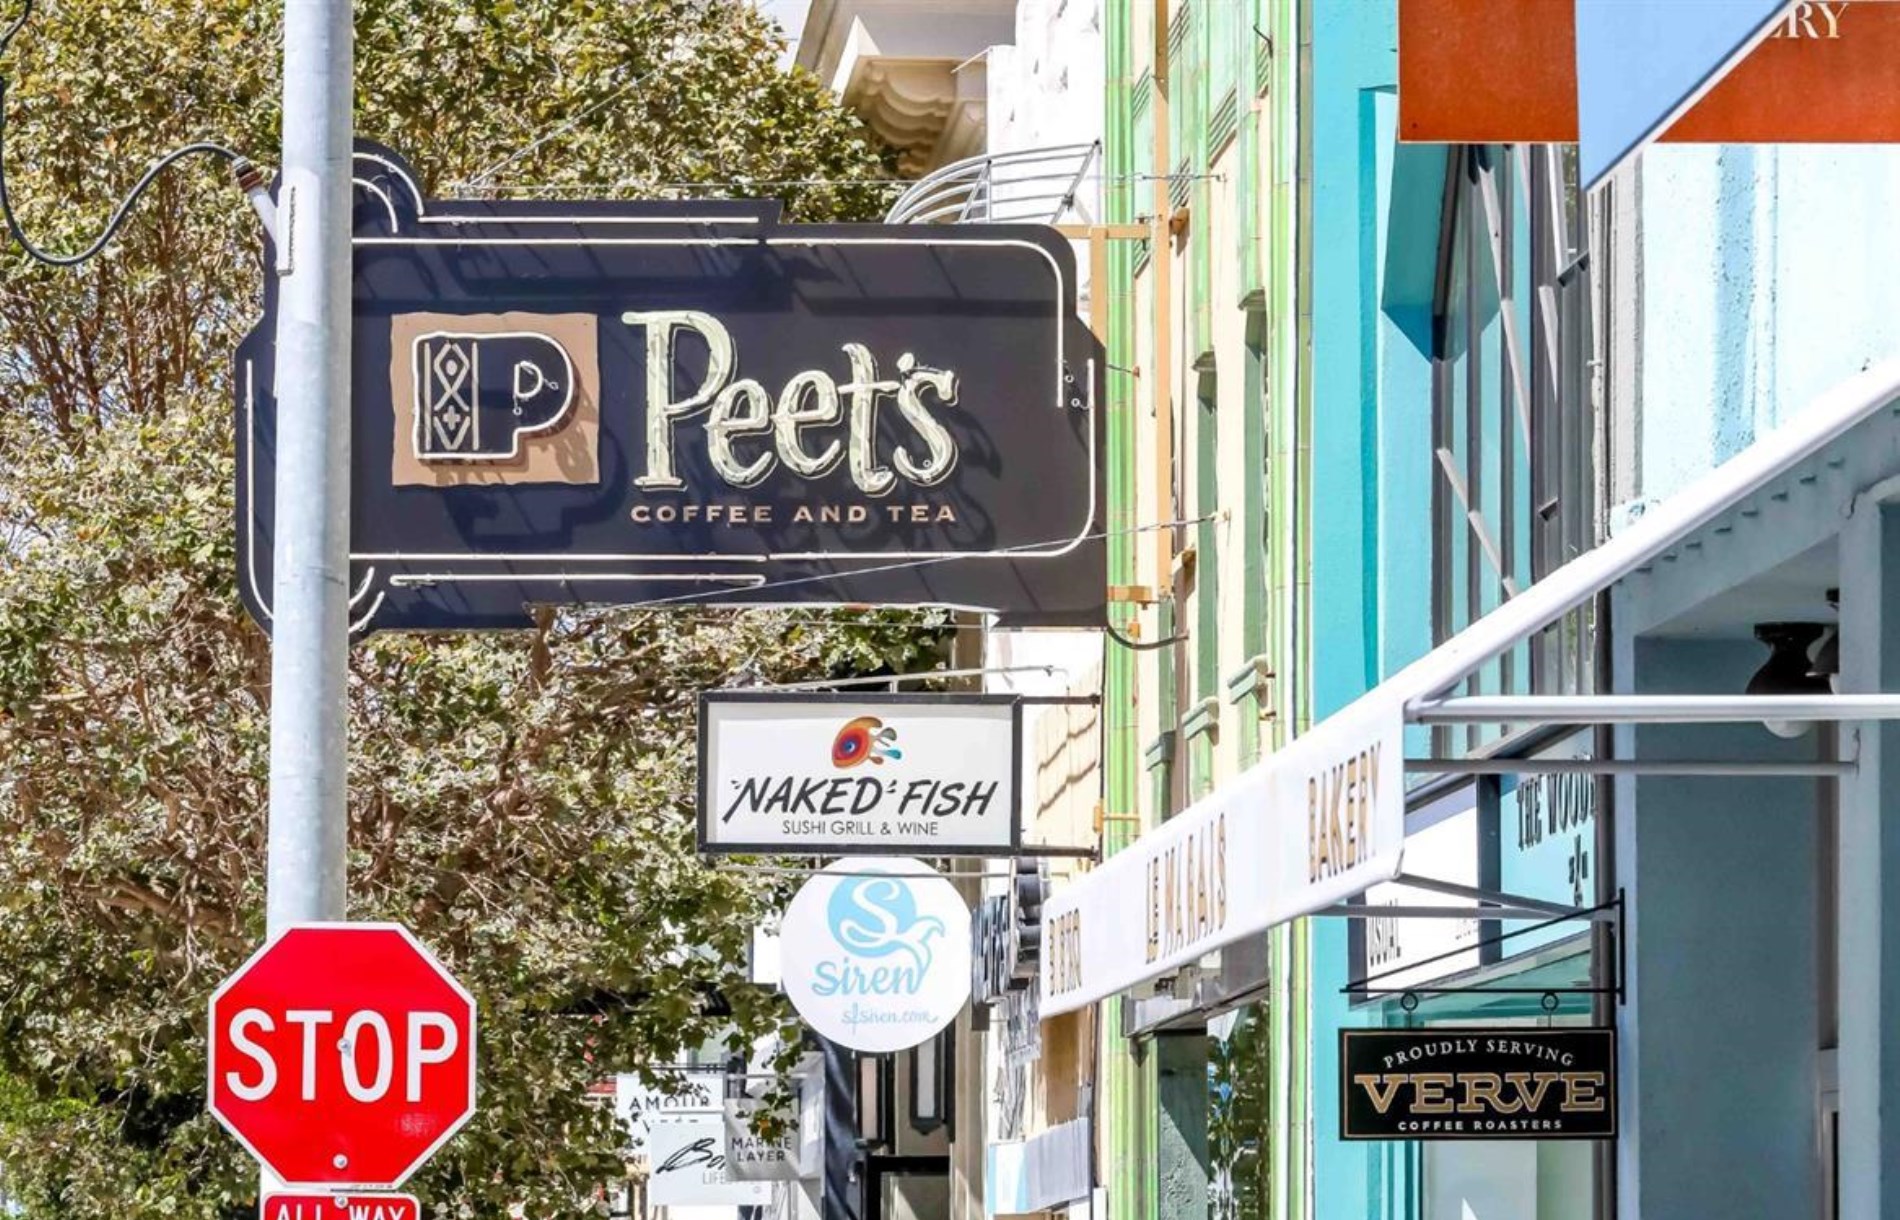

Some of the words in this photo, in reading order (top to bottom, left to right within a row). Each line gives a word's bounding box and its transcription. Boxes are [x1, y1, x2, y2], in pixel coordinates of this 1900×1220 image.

[621, 311, 958, 497] Peet's
[631, 504, 772, 523] COFFEE
[793, 504, 867, 523] AND
[888, 504, 957, 523] TEA
[898, 780, 999, 817] FISH
[1308, 740, 1381, 884] BAKERY
[1516, 773, 1542, 852] THE
[782, 820, 826, 835] SUSHI
[831, 820, 873, 835] GRILL
[880, 820, 891, 835] &
[898, 820, 938, 836] WINE
[811, 957, 920, 997] Siren
[225, 1008, 459, 1103] STOP
[1383, 1039, 1478, 1069] PROUDLY
[1487, 1039, 1575, 1067] SERVING
[1354, 1071, 1605, 1114] VERVE
[731, 1137, 792, 1150] MARNE
[1397, 1120, 1464, 1132] COFFEE
[1474, 1119, 1563, 1131] ROASTERS
[736, 1151, 786, 1162] LAYER
